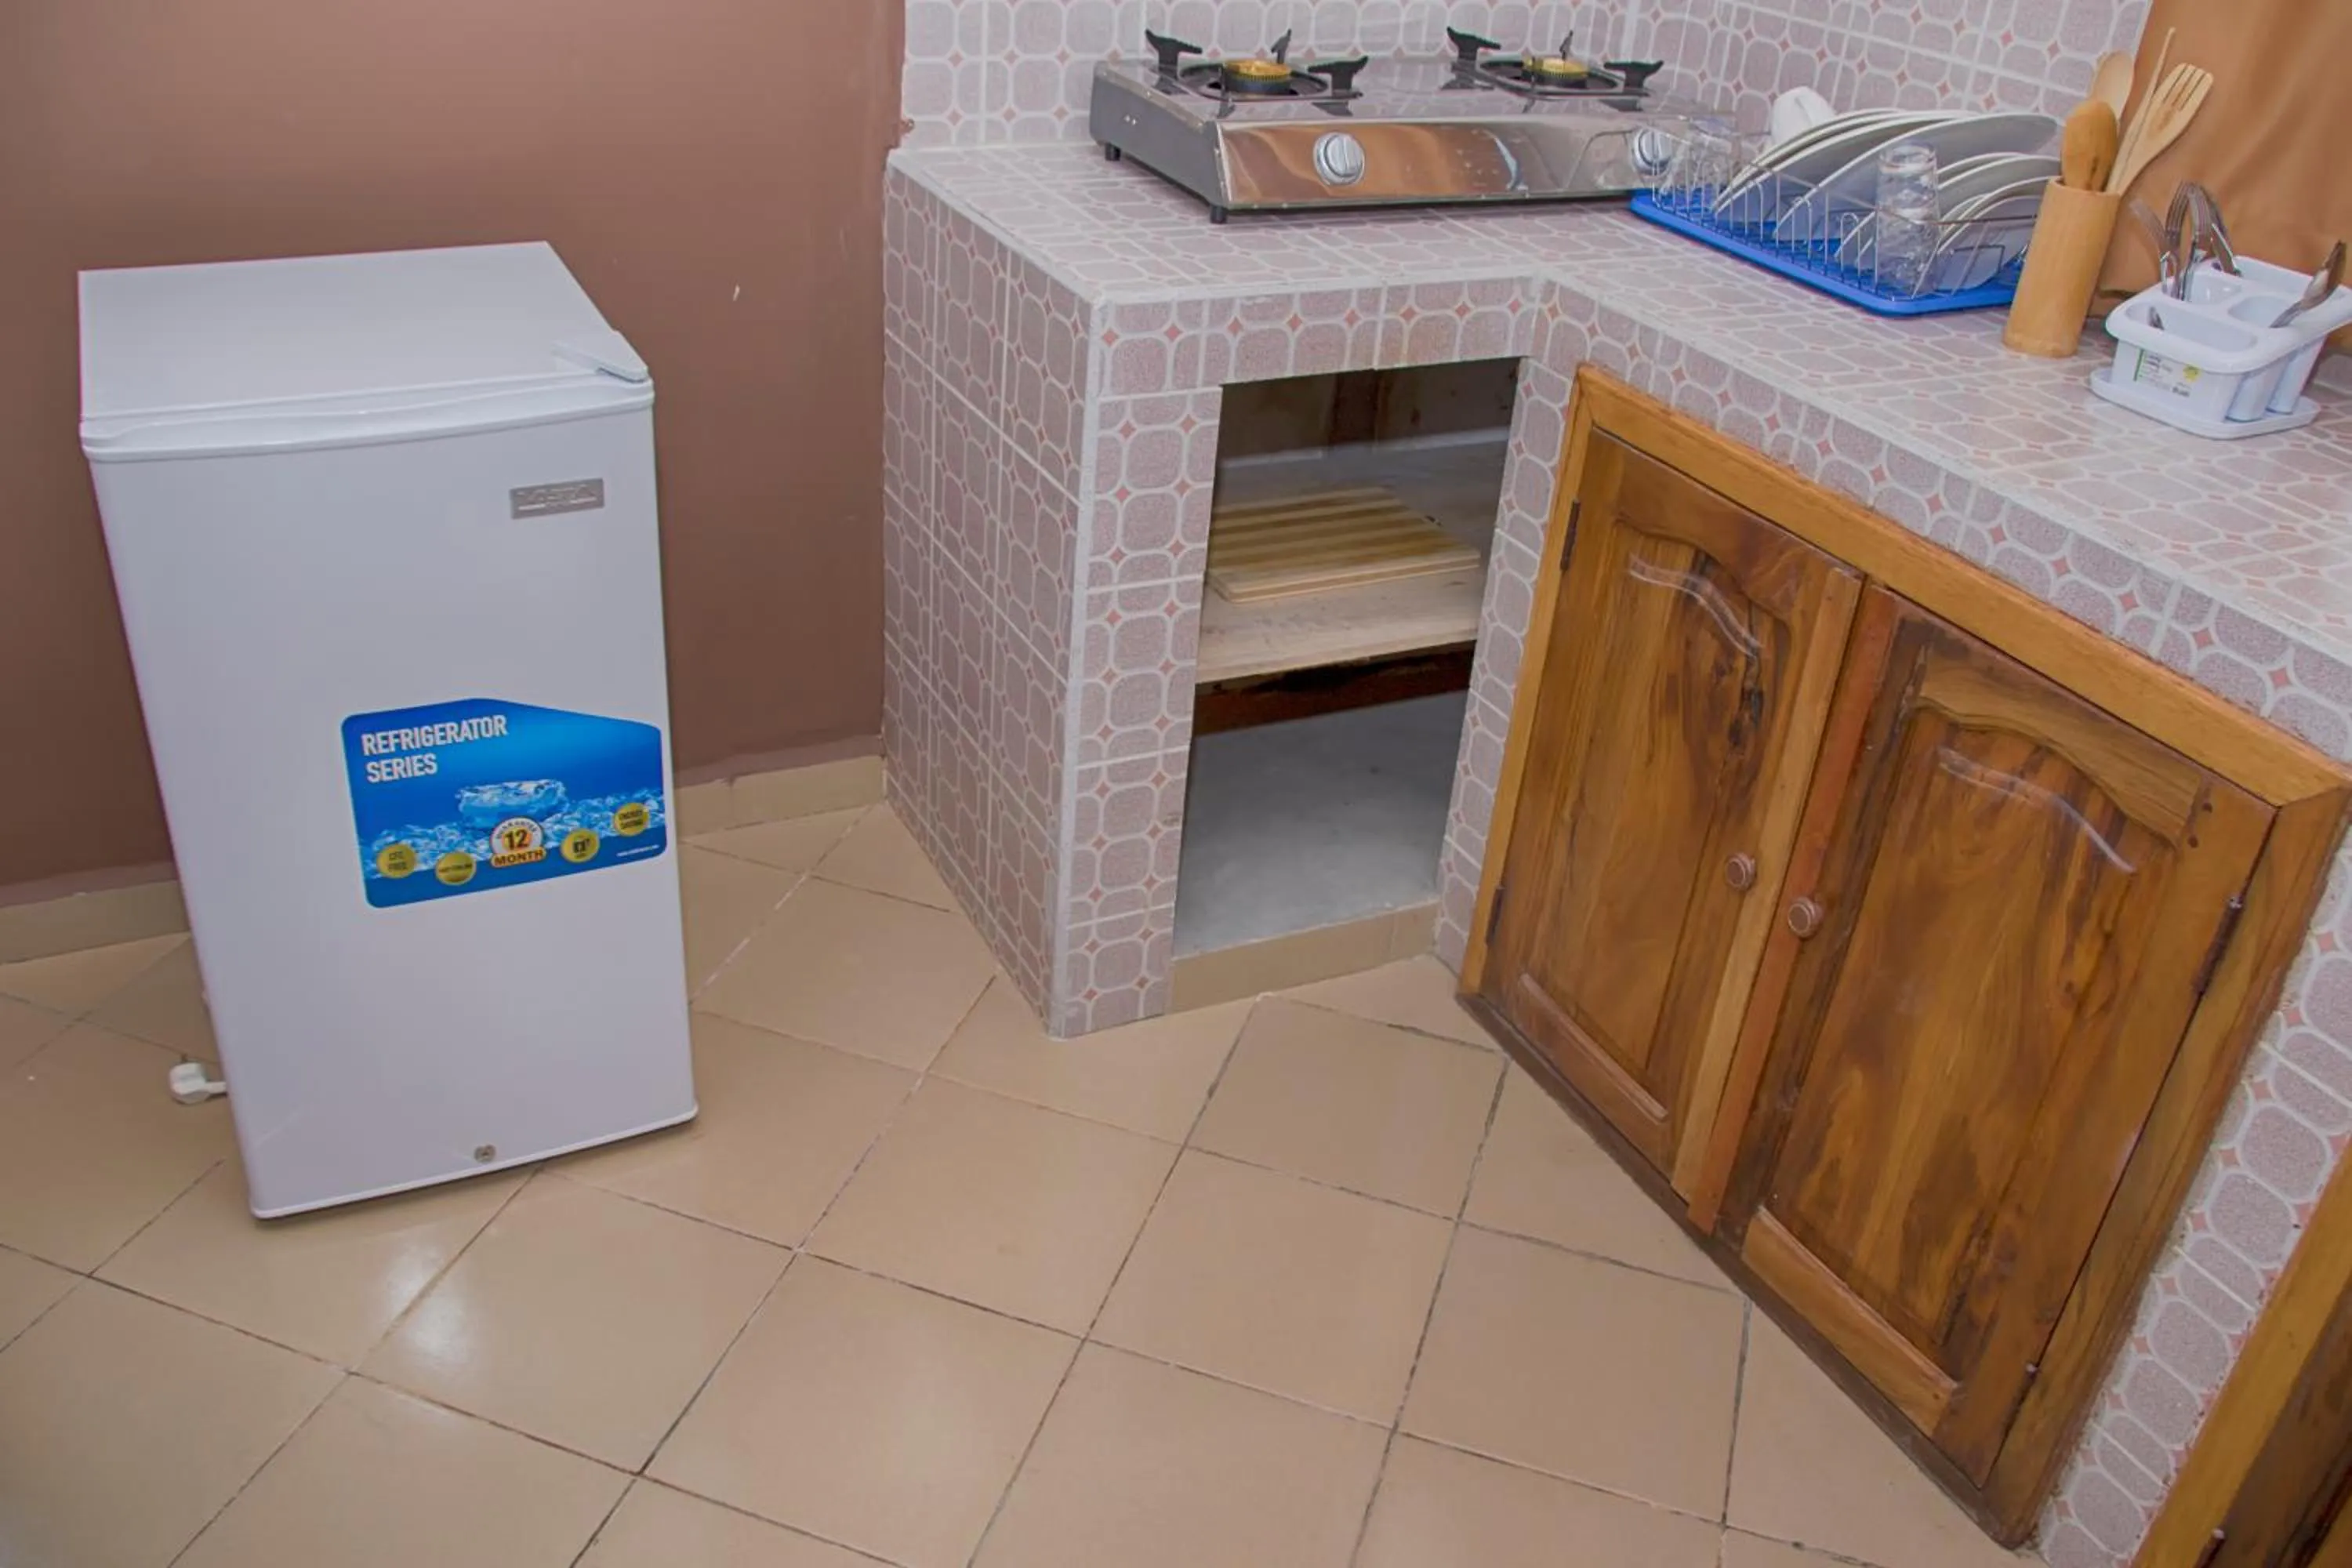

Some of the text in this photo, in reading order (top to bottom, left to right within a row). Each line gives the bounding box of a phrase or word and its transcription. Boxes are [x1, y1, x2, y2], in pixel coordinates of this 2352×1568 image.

[361, 714, 507, 756] REFRIGERATOR
[366, 753, 438, 783] SERIES
[504, 829, 529, 850] 12
[495, 849, 543, 866] MONTH
